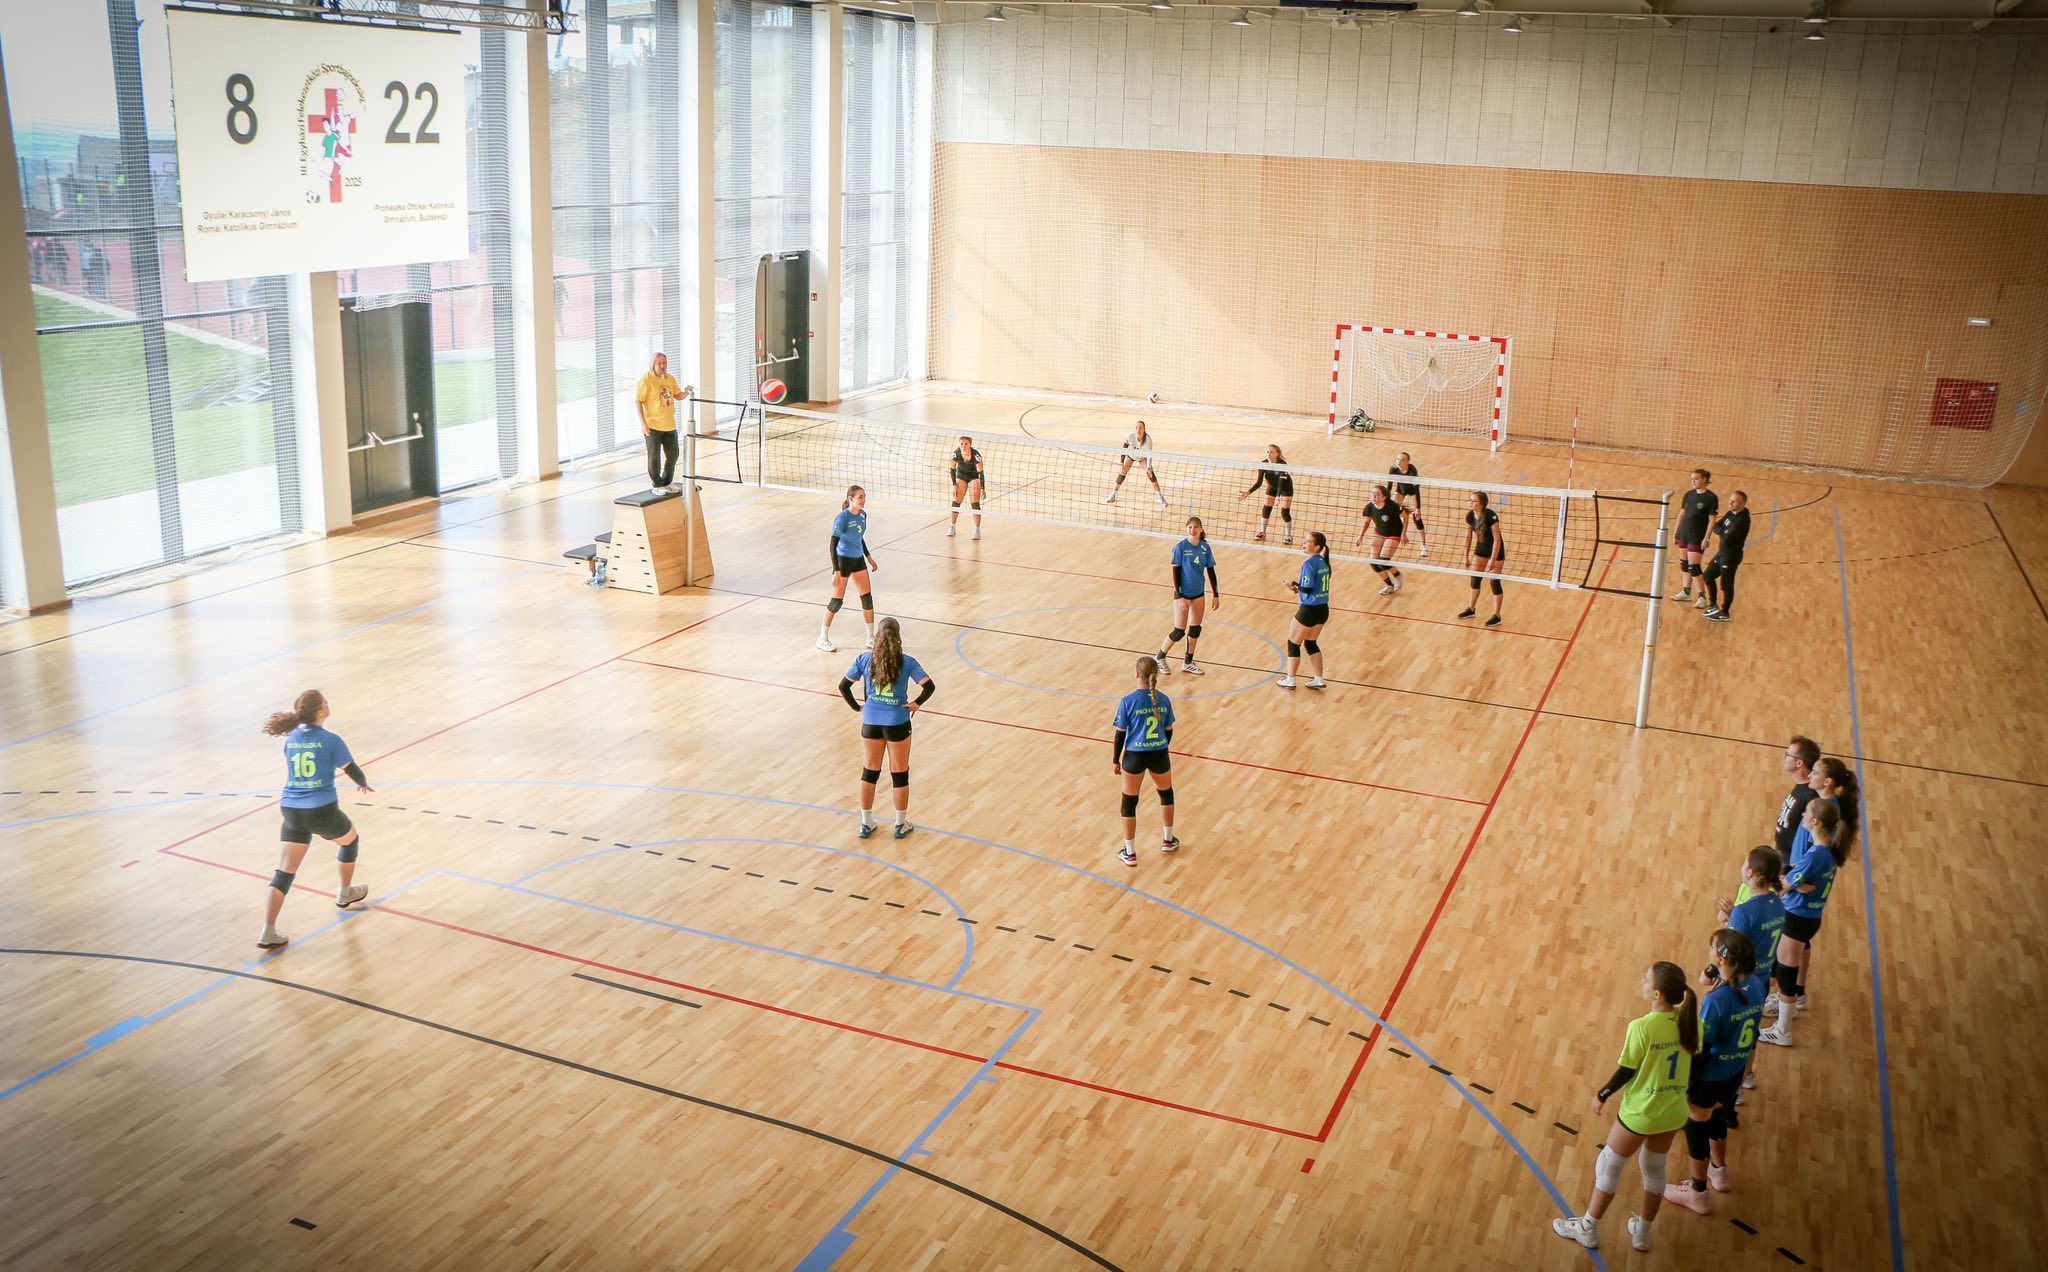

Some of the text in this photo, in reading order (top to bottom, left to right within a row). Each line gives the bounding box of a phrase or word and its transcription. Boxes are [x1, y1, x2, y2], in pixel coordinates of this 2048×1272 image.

[225, 73, 258, 145] 8
[383, 80, 440, 144] 22
[345, 176, 362, 188] 2025
[1193, 556, 1200, 565] 4
[1146, 716, 1158, 739] 2
[290, 751, 316, 778] 16
[1737, 1018, 1755, 1048] 6
[1666, 1050, 1680, 1080] 1
